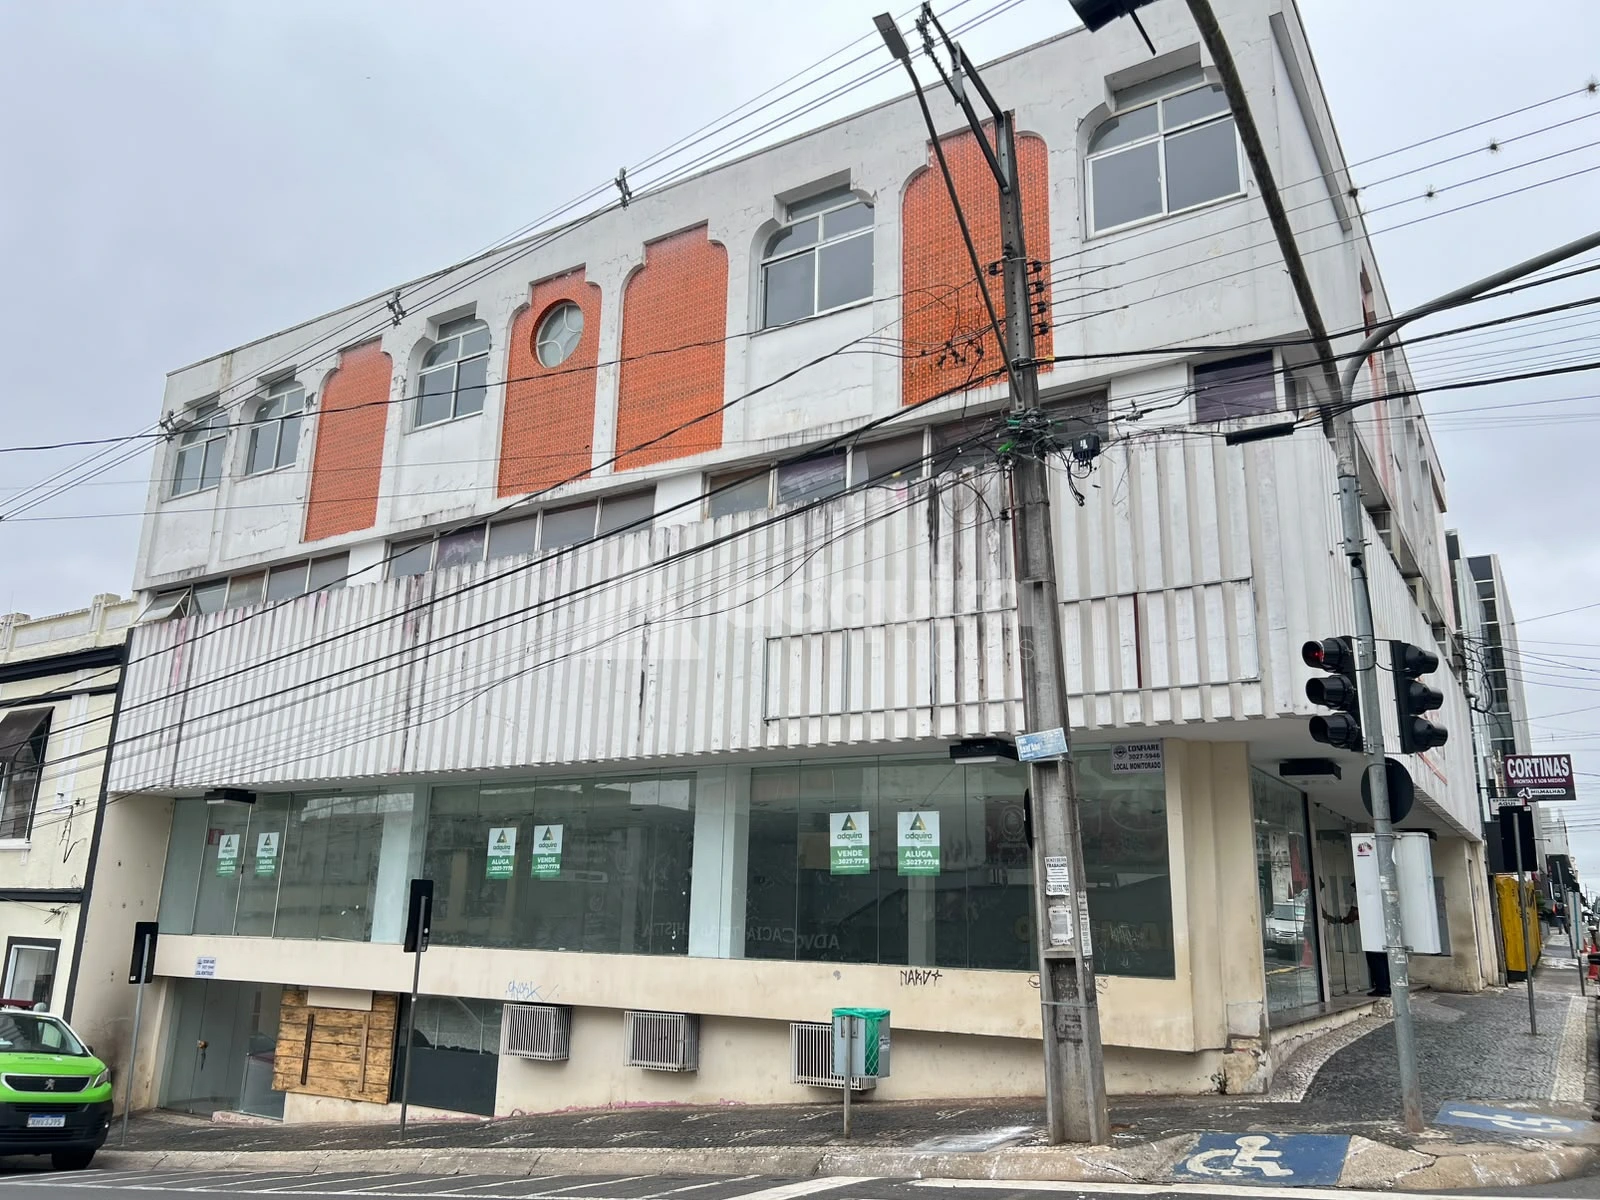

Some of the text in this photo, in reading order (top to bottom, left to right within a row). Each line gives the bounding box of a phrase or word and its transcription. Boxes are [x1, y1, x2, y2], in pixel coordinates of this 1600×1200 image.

[1127, 744, 1160, 752] CONFIARE
[1129, 761, 1161, 769] MONITORADO
[1506, 757, 1570, 778] CORTINAS
[837, 832, 862, 840] adquira
[905, 832, 932, 840] adquira
[905, 850, 933, 858] ALUGA
